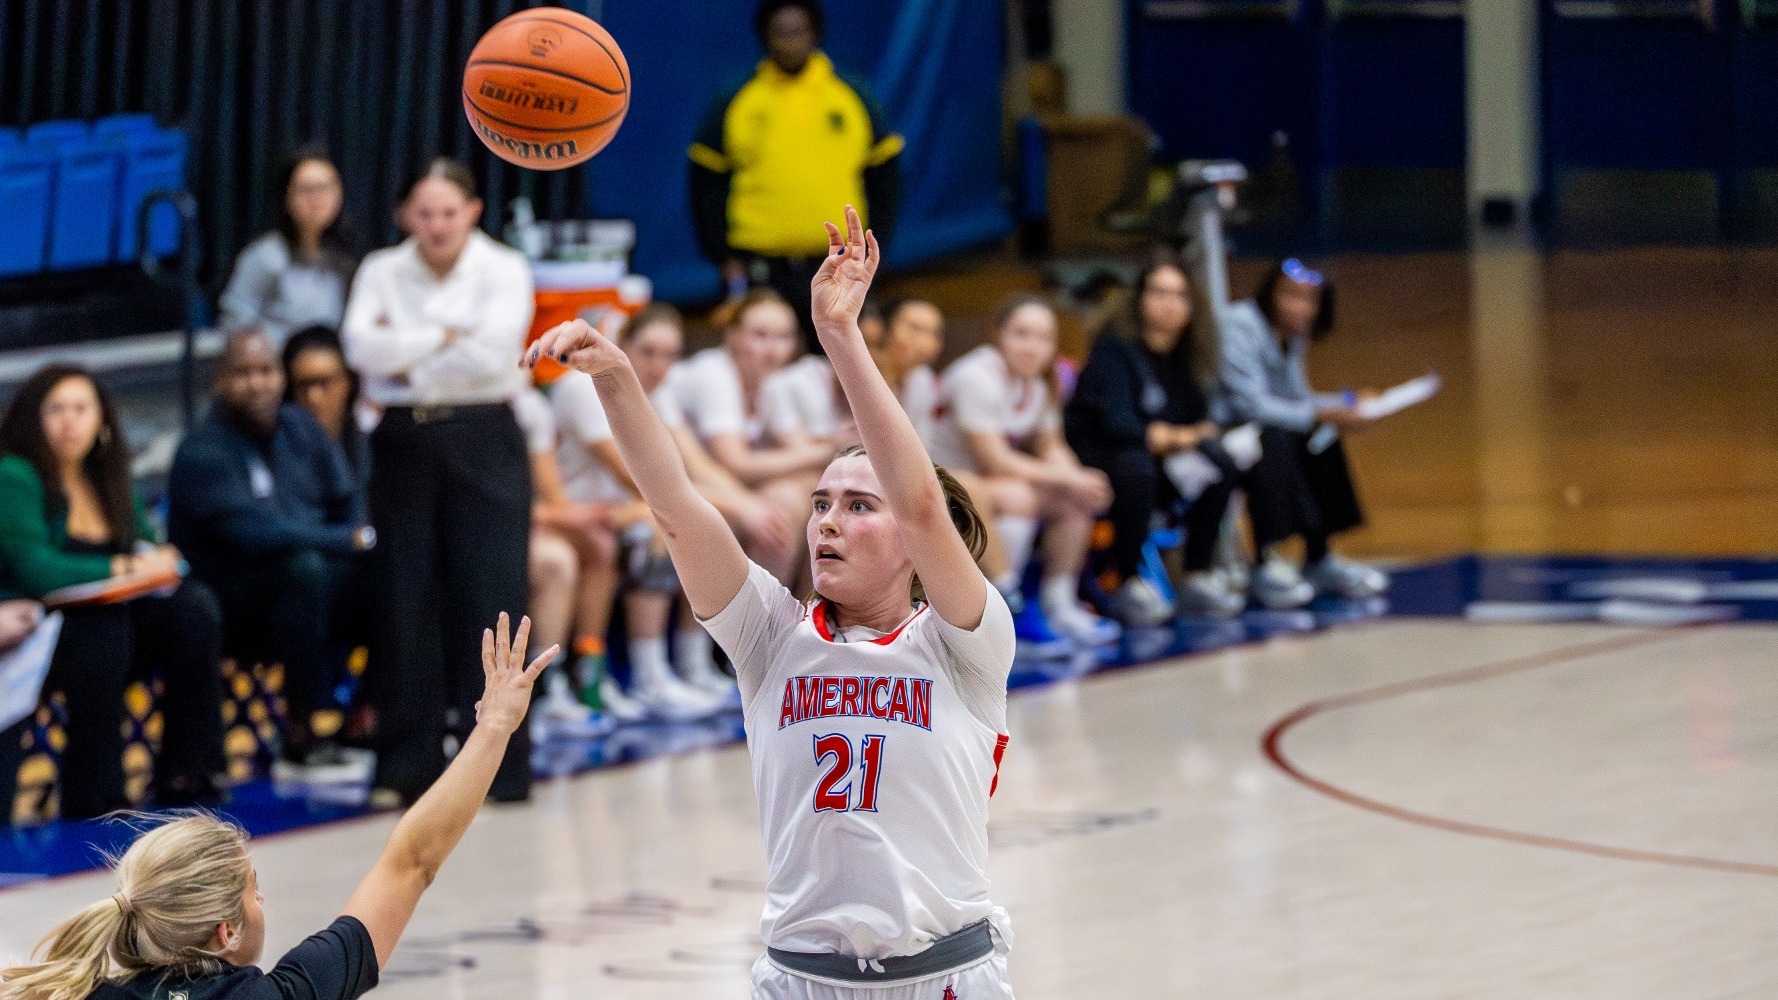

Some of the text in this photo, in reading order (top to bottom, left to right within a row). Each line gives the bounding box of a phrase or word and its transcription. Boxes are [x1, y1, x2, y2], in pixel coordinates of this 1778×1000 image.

[475, 117, 579, 160] Wilson
[778, 676, 933, 732] AMERICAN
[813, 732, 886, 813] 21
